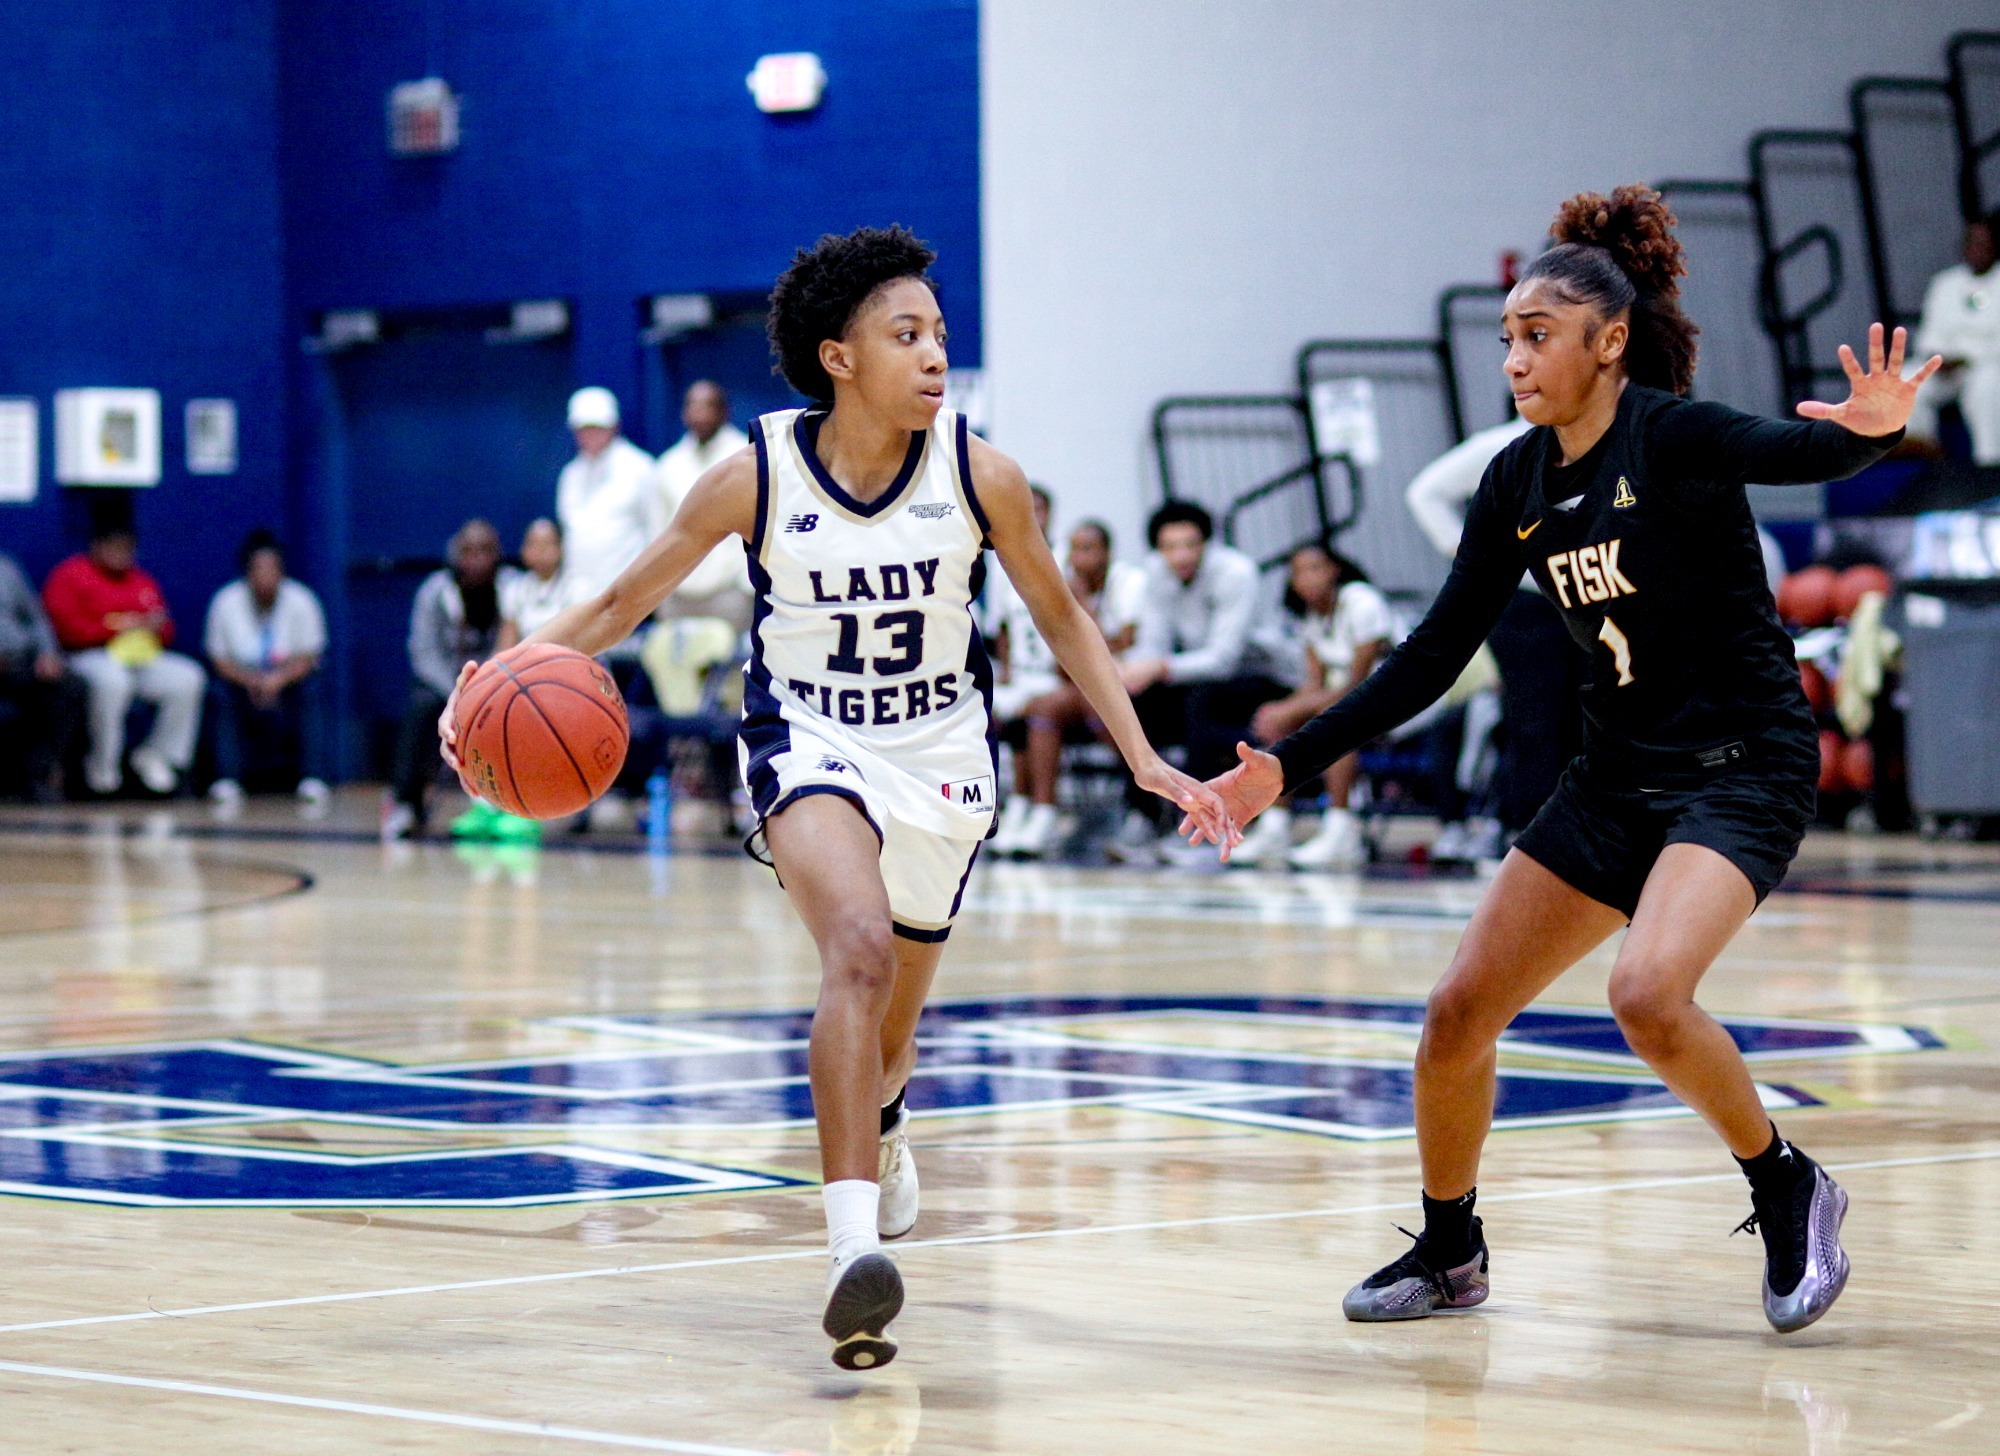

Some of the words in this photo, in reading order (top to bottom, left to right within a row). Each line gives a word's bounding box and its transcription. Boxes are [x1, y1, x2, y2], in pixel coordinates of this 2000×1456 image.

[808, 557, 940, 603] LADY
[1547, 538, 1638, 609] FISK
[826, 609, 925, 676] 13
[1598, 615, 1636, 687] 1
[788, 672, 958, 726] TIGERS
[1731, 749, 1740, 758] S
[962, 783, 982, 804] M
